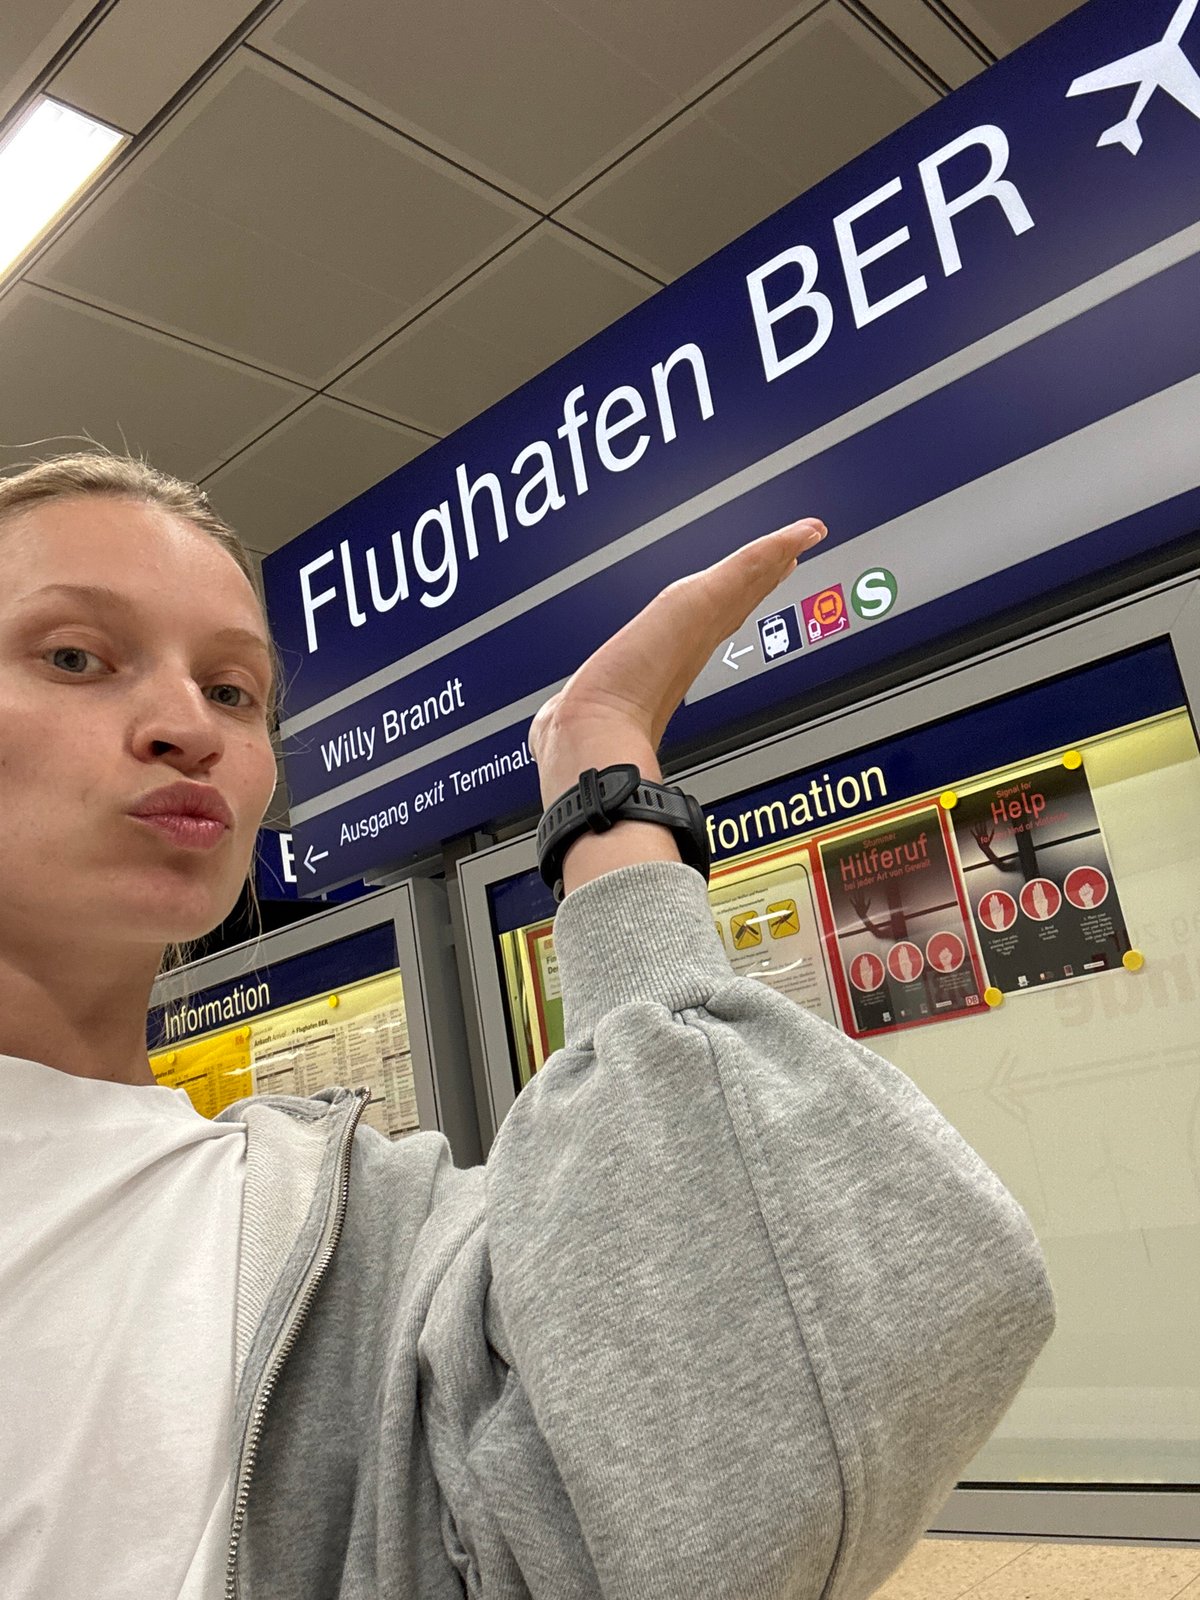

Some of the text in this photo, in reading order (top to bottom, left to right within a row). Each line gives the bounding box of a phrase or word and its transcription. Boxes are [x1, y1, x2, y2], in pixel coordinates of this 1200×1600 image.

[297, 124, 1036, 654] Flughafen BER
[855, 571, 893, 618] S
[320, 677, 466, 772] Willy Brandt
[339, 799, 409, 846] Ausgang
[414, 779, 445, 813] exit
[449, 740, 536, 796] Terminal
[992, 792, 1045, 824] Help
[996, 781, 1032, 798] Signal for
[705, 765, 888, 855] formation
[1025, 821, 1034, 831] of
[841, 832, 927, 880] Hilferuf
[863, 832, 897, 848] Stummer
[844, 860, 931, 892] bei jeder Art von Gewalt
[164, 982, 271, 1039] Information
[966, 995, 979, 1006] DB
[254, 1035, 272, 1048] Ankunft
